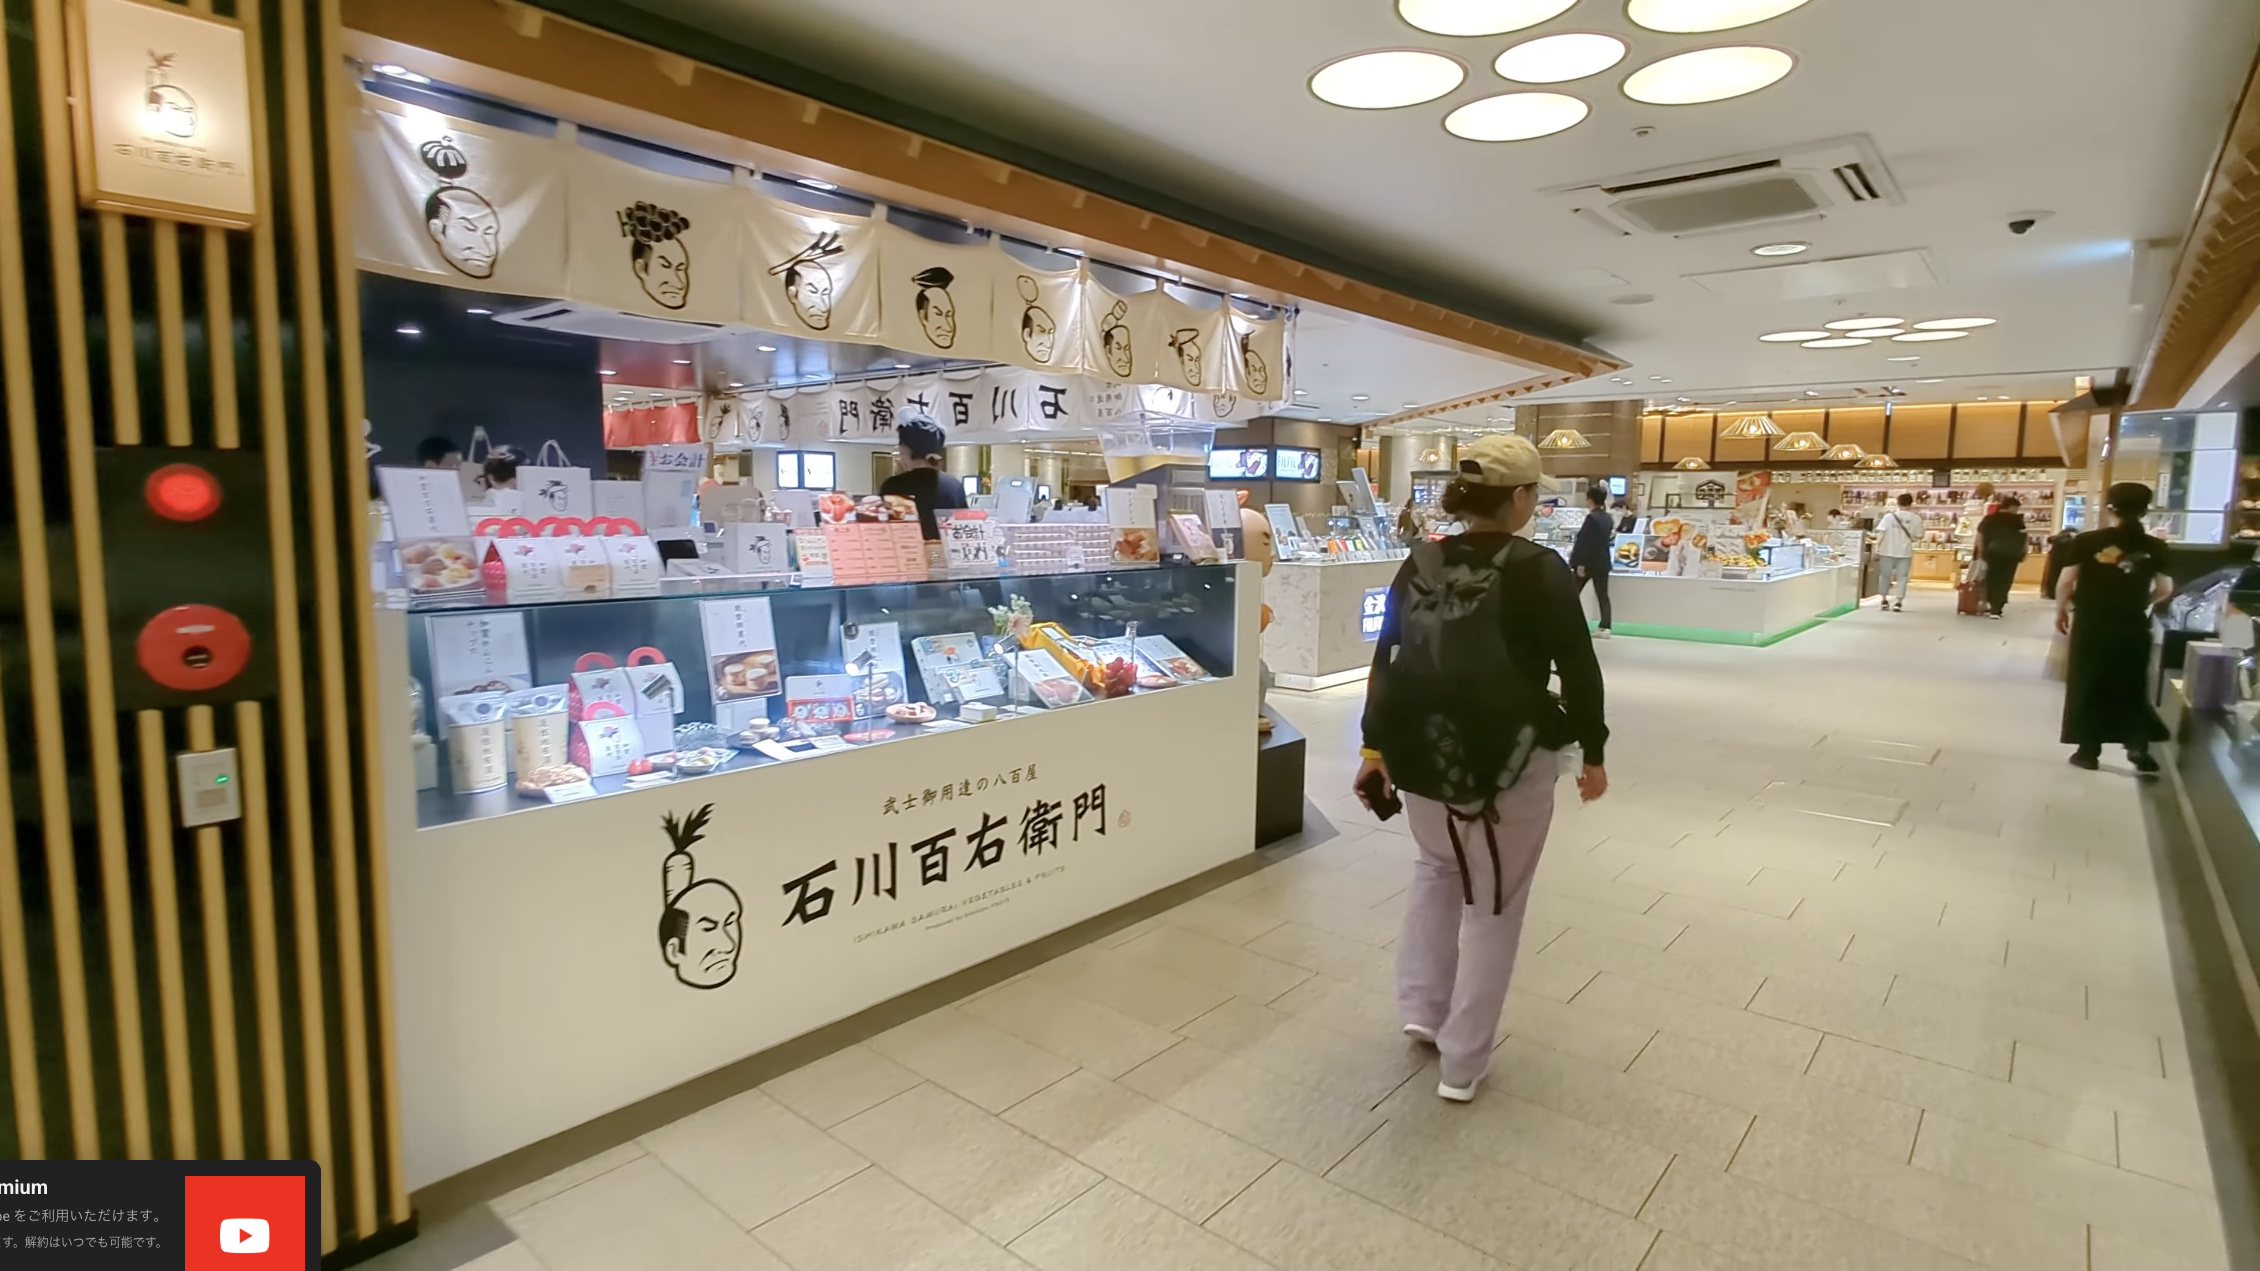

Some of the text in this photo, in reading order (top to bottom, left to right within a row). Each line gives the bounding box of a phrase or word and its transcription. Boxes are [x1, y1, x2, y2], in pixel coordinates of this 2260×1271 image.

[882, 763, 1038, 817] 武士御用達の八百屋
[781, 783, 1107, 928] 石川百右衛門
[853, 920, 905, 943] ISHIKAWA
[911, 903, 958, 924] SAMURAI
[962, 879, 1022, 906] VEGETABLES
